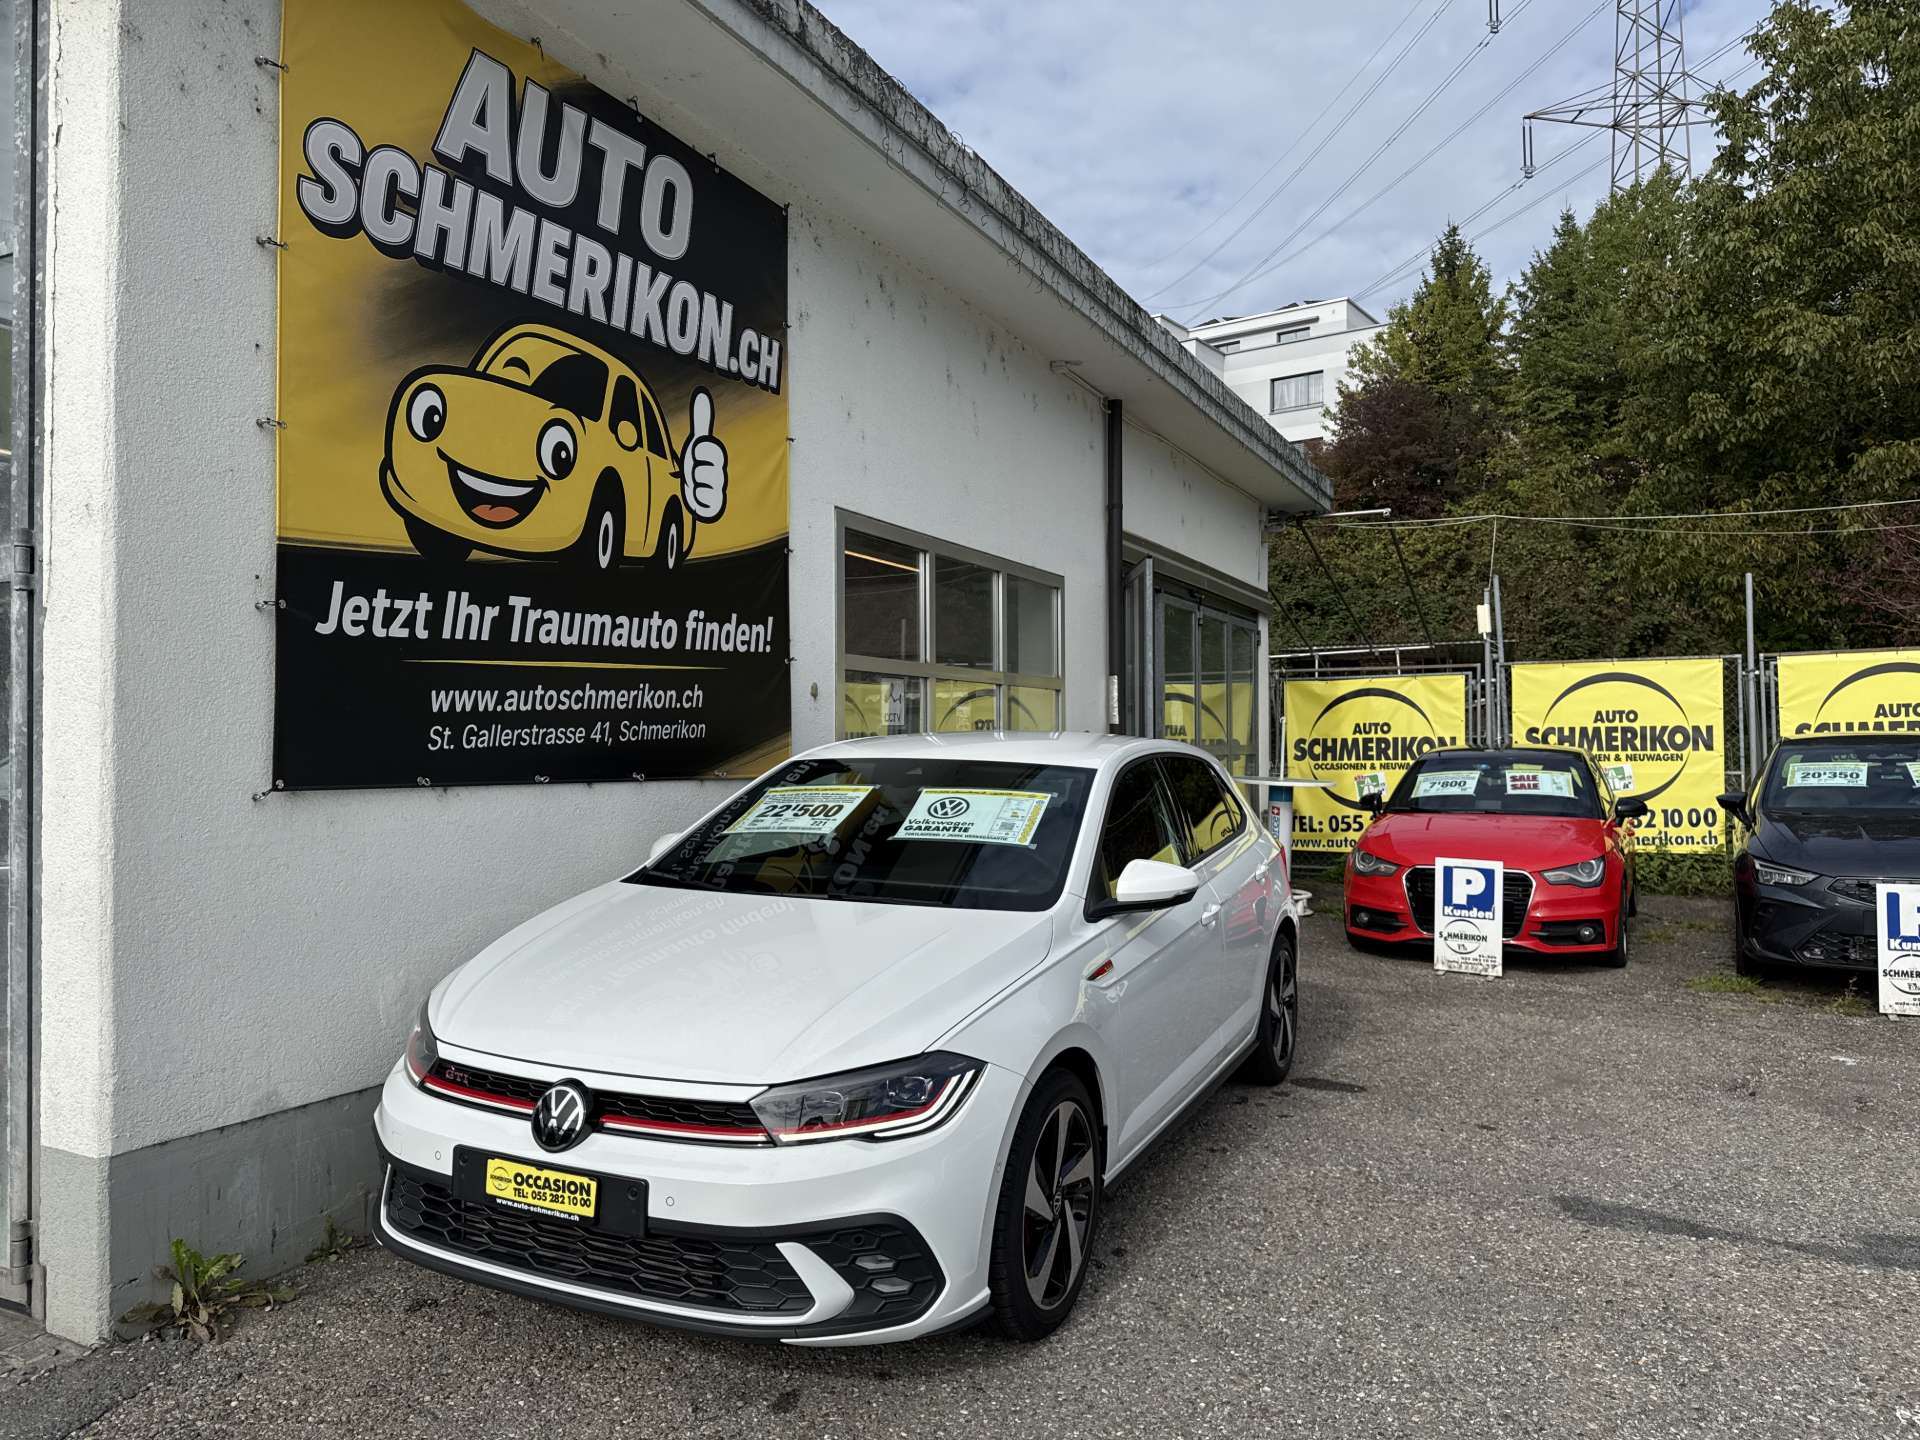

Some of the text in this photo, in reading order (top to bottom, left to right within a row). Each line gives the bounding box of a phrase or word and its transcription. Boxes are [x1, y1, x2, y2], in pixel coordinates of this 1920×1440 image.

[433, 47, 695, 260] AUTO
[298, 118, 782, 391] SCHMERIKON.CH
[315, 580, 774, 653] Jetzt Ihr Traumauto finden!
[430, 683, 704, 712] www.autoschmerikon.ch
[1593, 710, 1638, 724] AUTO
[428, 720, 706, 751] St. Gallerstrasse 41, Schmerikon
[1352, 722, 1391, 735] AUTO
[1525, 725, 1714, 752] SCHMERIKON
[1614, 753, 1622, 761] &
[1625, 752, 1684, 762] NEUWAGEN
[1313, 762, 1367, 770] OCCASIONEN
[1369, 762, 1376, 770] &
[1800, 771, 1861, 780] 20'350
[1429, 780, 1467, 789] 7'800
[756, 803, 844, 818] 22'500
[904, 825, 972, 833] GARANTIE
[909, 818, 975, 827] Volkswagen
[1328, 814, 1364, 833] 055
[1452, 867, 1486, 906] P
[1443, 904, 1494, 920] Kunden
[1889, 938, 1920, 952] Kun
[513, 1172, 592, 1197] OCCASION
[513, 1187, 592, 1208] TEL: 055 282 10 00
[496, 1198, 580, 1222] www.auto-schmerikon.ch
